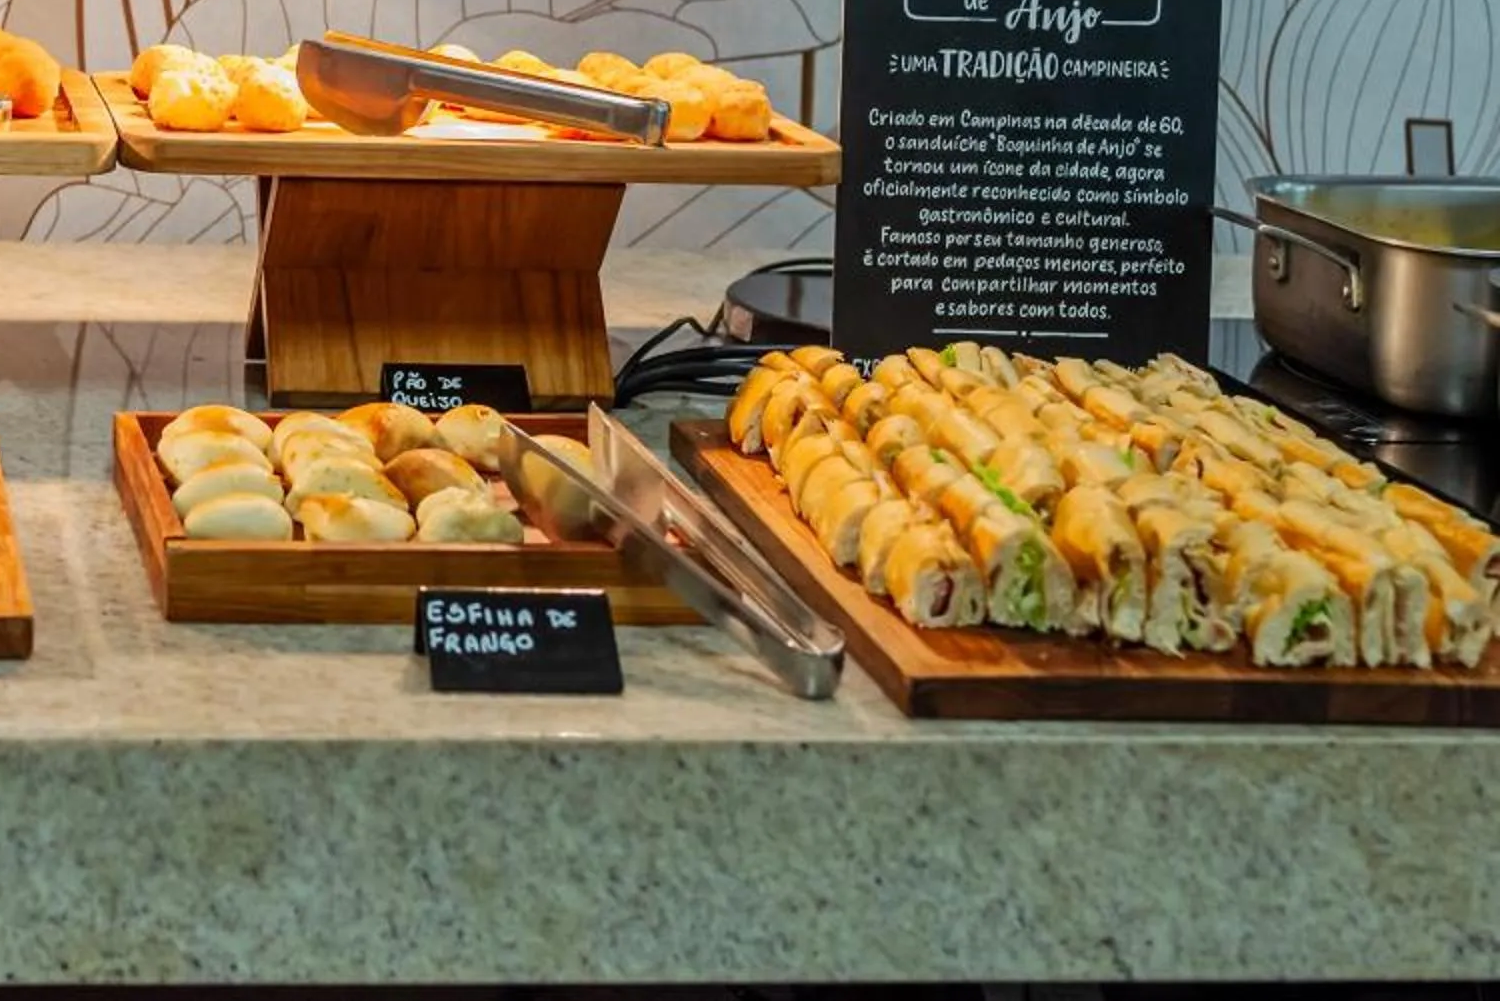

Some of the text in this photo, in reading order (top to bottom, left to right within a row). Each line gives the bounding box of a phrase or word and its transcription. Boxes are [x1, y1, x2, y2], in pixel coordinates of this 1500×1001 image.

[901, 47, 1158, 84] UMA TRADIÇÃO CAMPINEIRA
[869, 109, 1184, 136] Criado em Campinas na década de 60,
[885, 136, 894, 149] o
[897, 133, 987, 151] sanduíche
[1077, 137, 1095, 155] de
[1143, 142, 1163, 157] se
[884, 156, 1165, 184] tornou um ícone da cidade, agora
[863, 178, 1189, 205] oficialmente reconhecido como símbolo
[919, 207, 1131, 227] gastronômico e cultural.
[880, 226, 1165, 256] Famoso por seu tamanho generoso,
[863, 249, 1186, 277] é cortado em pedaços menores, perfeito
[891, 274, 1158, 296] para compartilhar momentos
[935, 300, 1112, 320] e sabores com todos.
[437, 376, 462, 389] DE
[426, 600, 578, 628] ESFIHA DE
[428, 626, 535, 655] FRANGO
